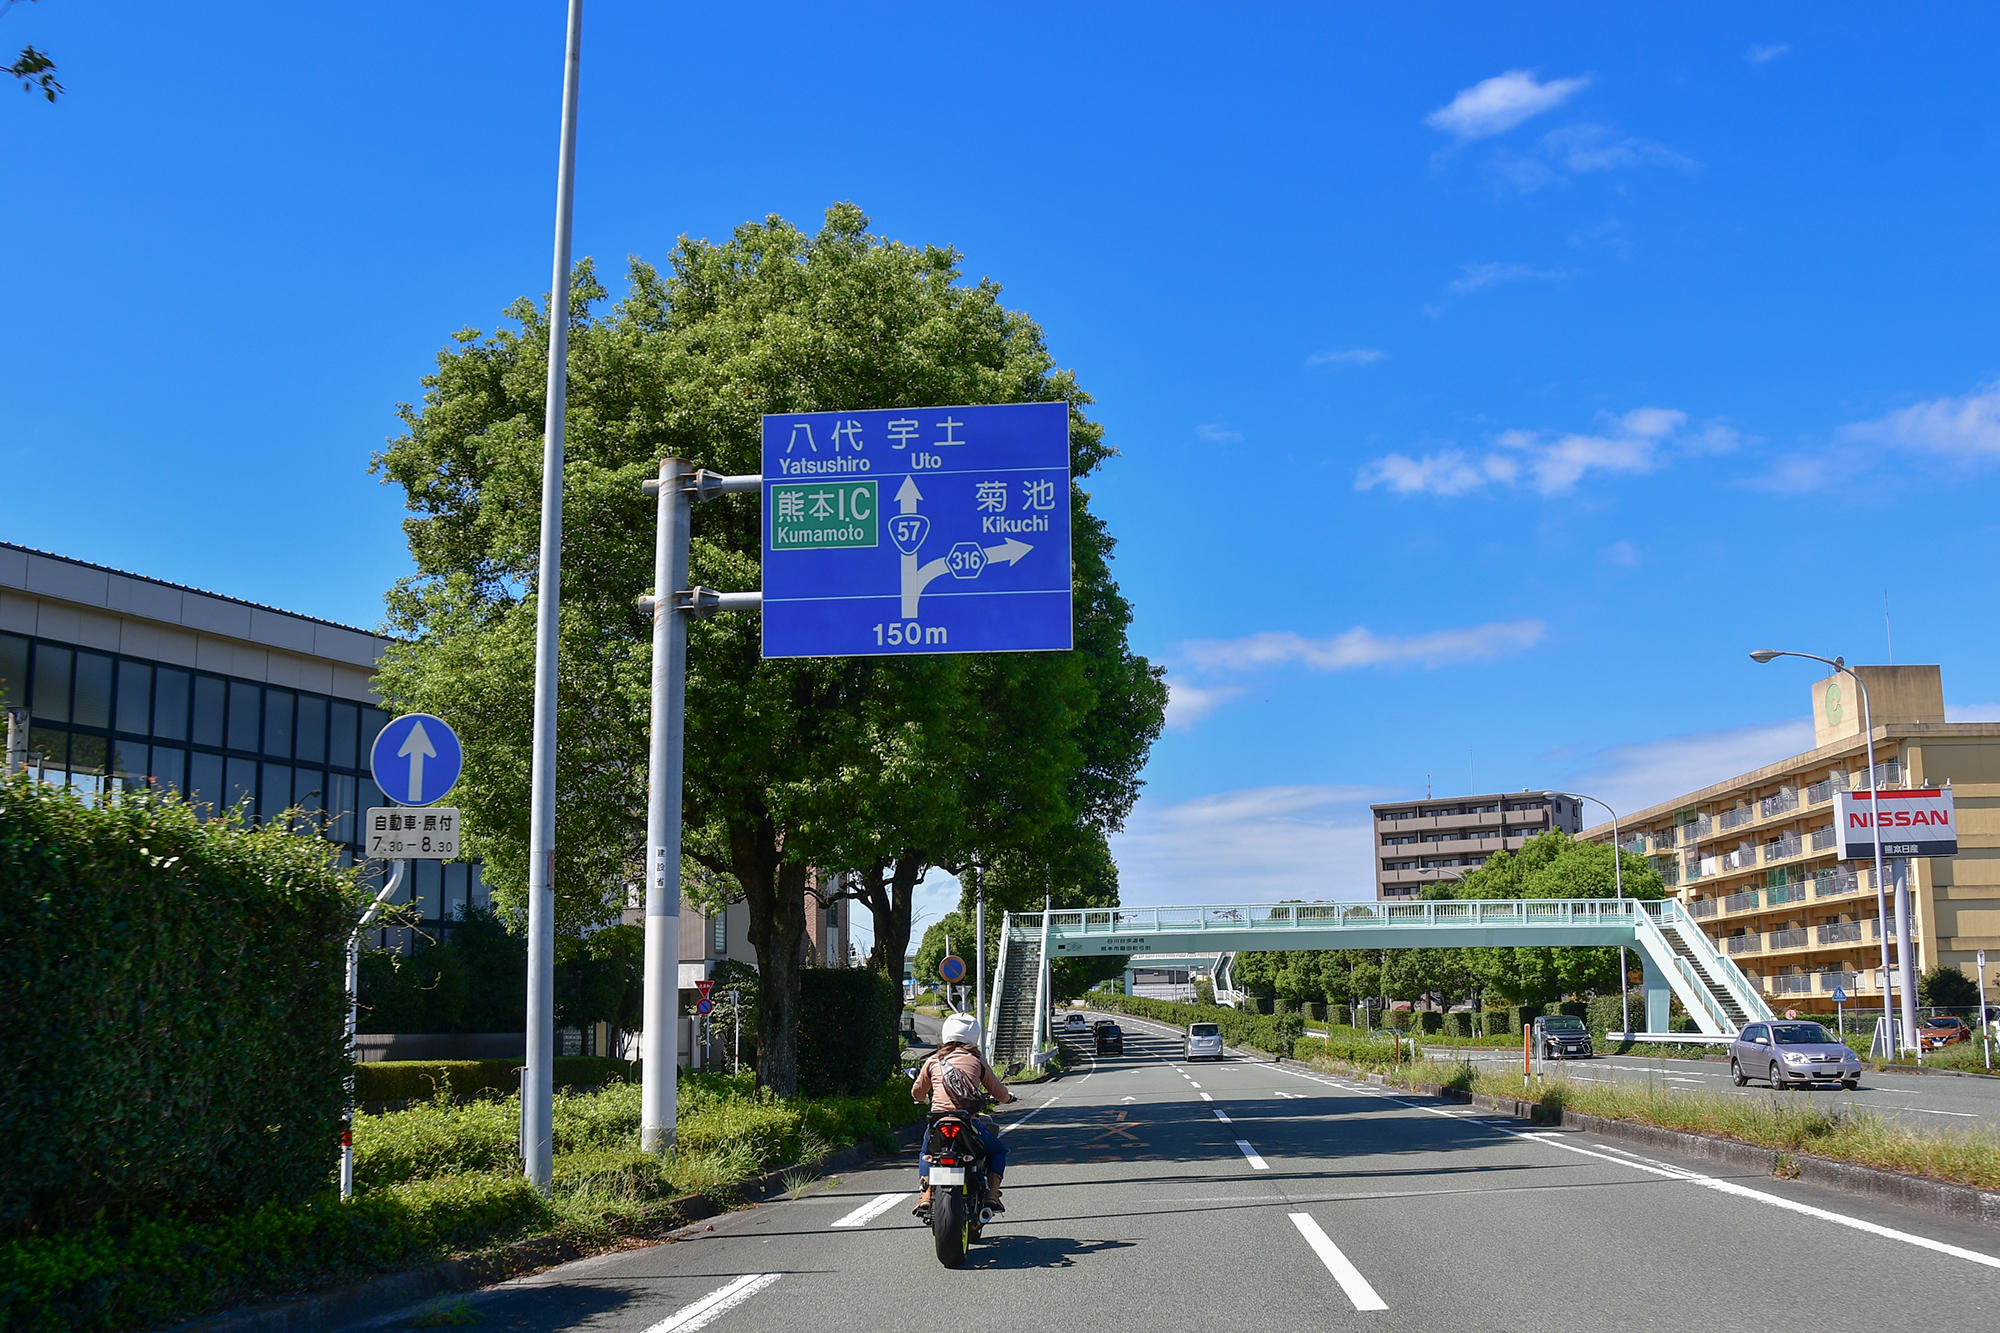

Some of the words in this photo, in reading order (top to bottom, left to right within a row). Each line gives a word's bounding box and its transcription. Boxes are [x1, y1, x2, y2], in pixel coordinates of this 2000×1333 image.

[786, 419, 863, 453] 八代
[887, 416, 966, 450] 宇土
[779, 455, 871, 475] Yatsushiro
[911, 452, 942, 470] Uto
[975, 479, 1056, 513] 菊池
[777, 525, 865, 544] Kumamoto
[897, 521, 921, 542] 57
[982, 514, 1049, 534] Kikuchi
[952, 550, 980, 570] 316
[873, 622, 948, 646] 150m
[1849, 809, 1949, 828] NISSAN
